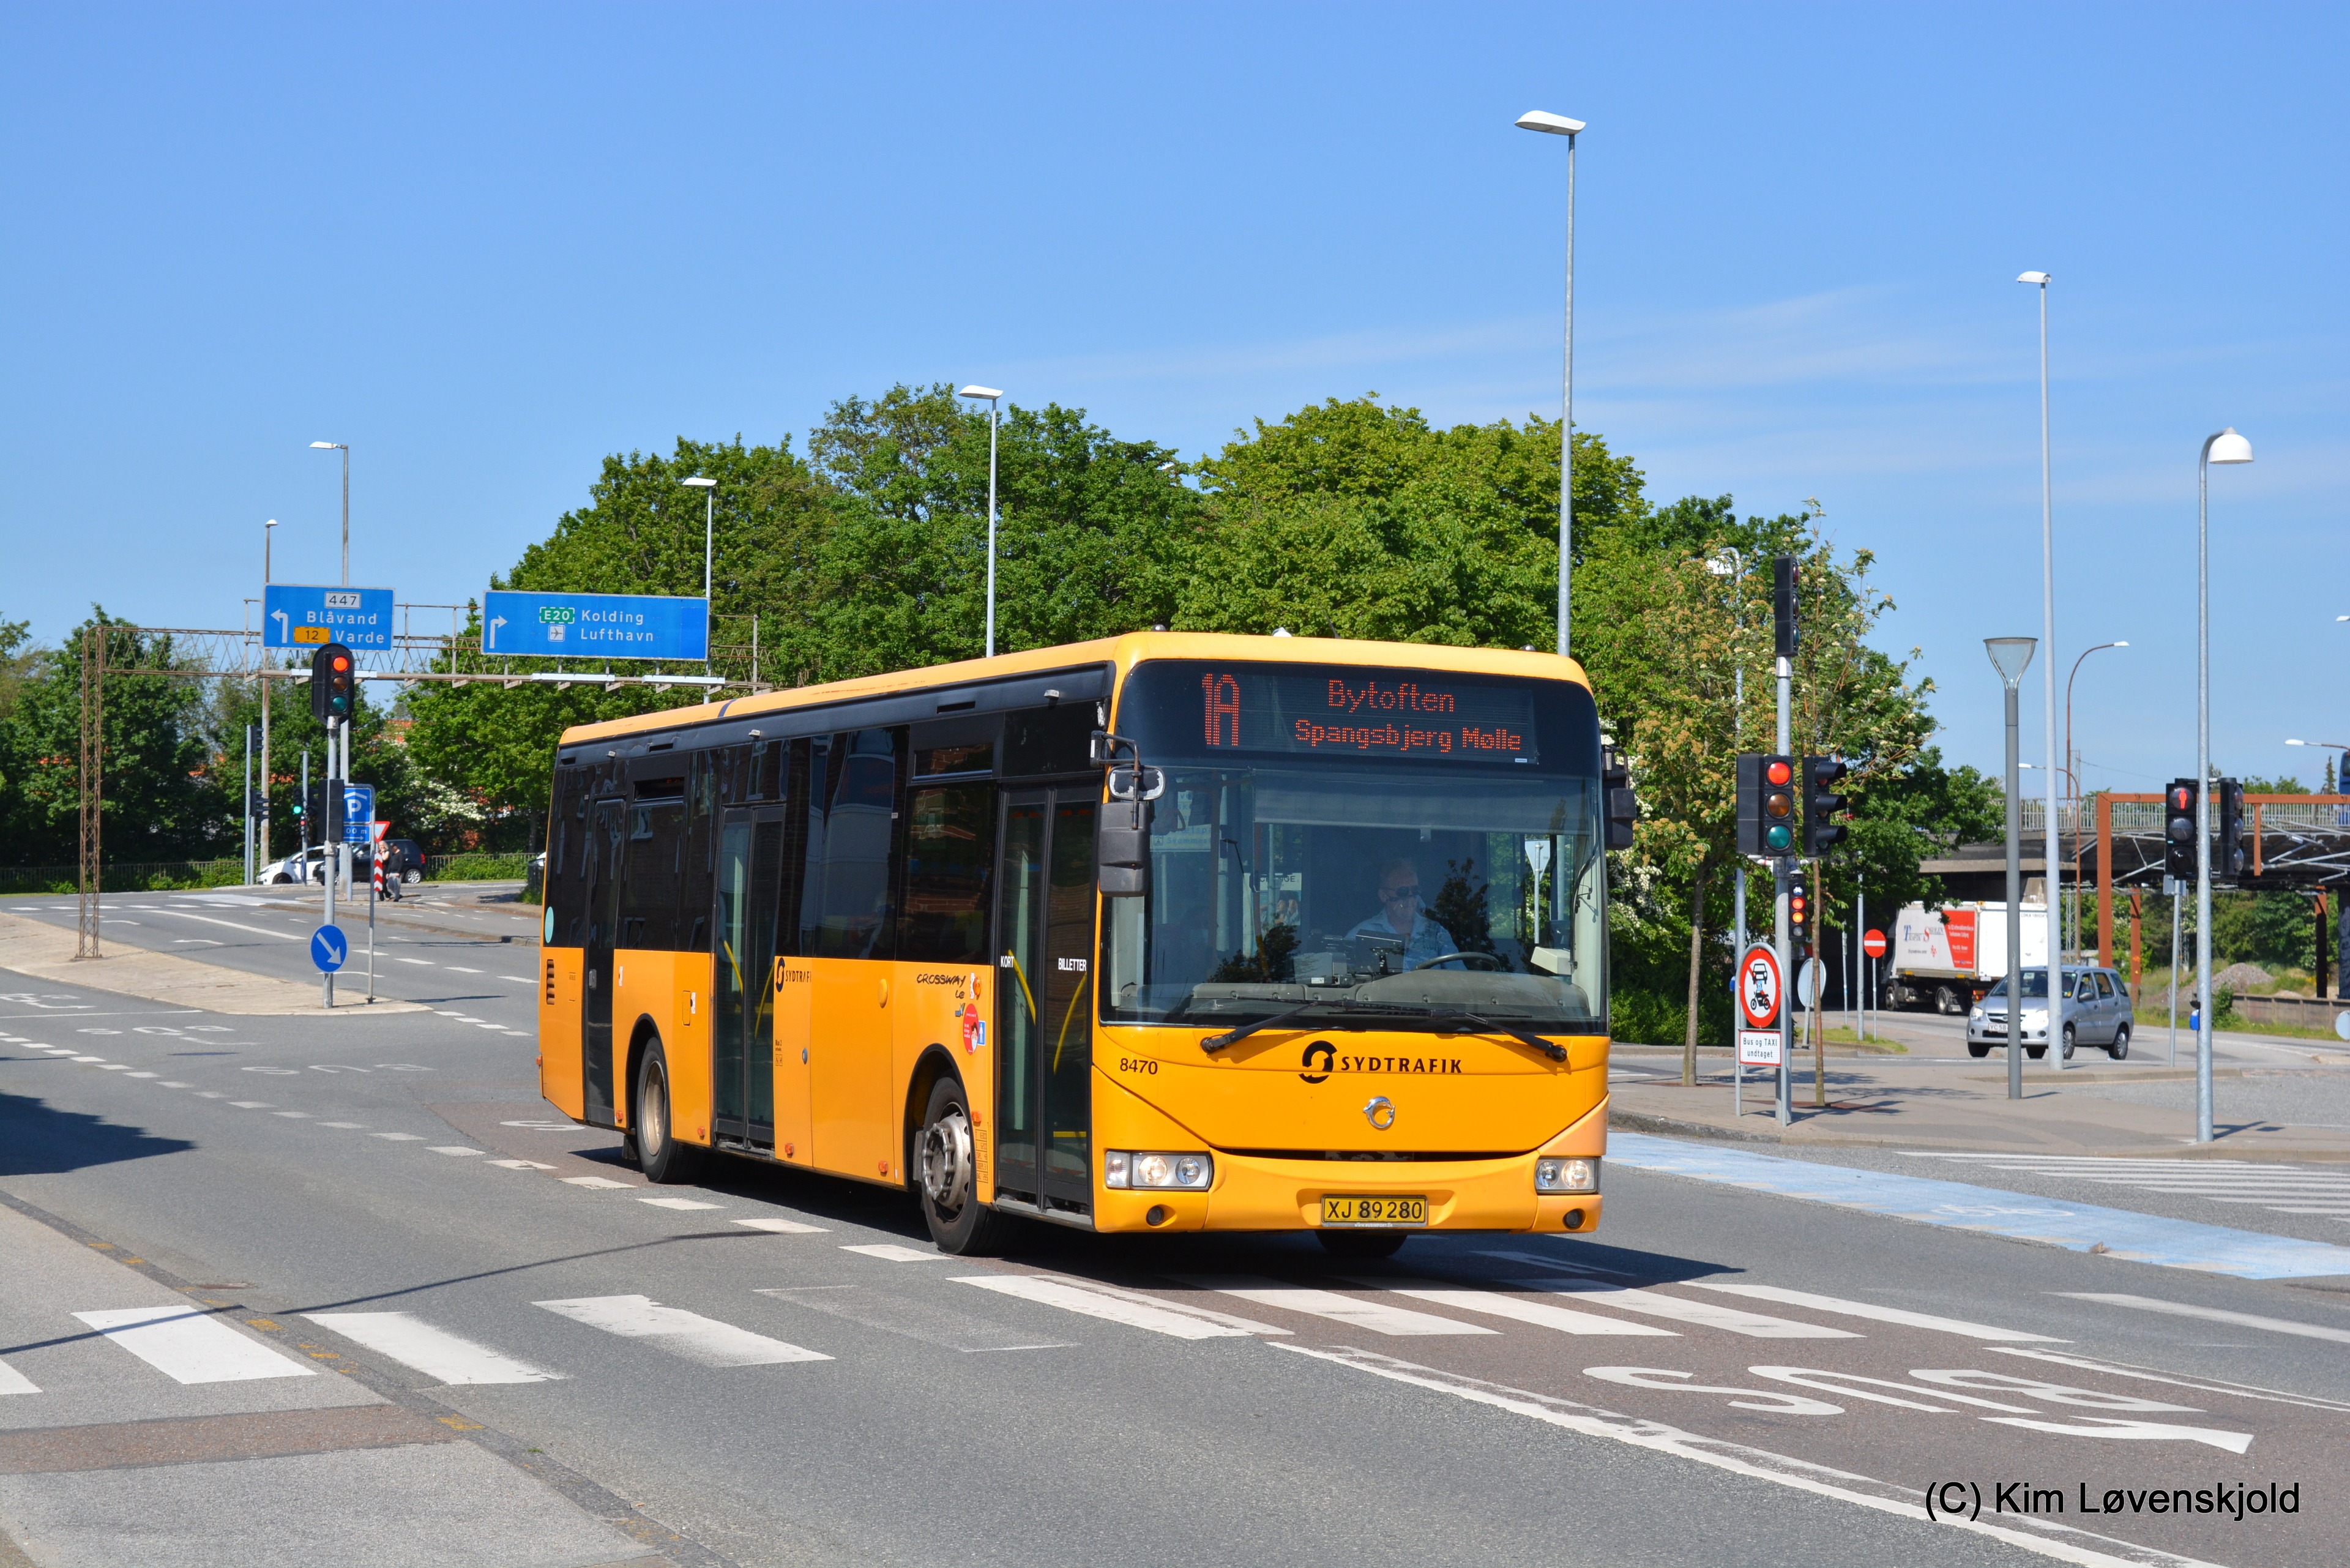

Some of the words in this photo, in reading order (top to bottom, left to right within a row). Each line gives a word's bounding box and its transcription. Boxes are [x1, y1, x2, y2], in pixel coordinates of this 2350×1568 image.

[329, 595, 357, 605] 447
[307, 611, 376, 624] Blåvand
[544, 610, 570, 621] E20
[581, 610, 643, 625] Kolding
[305, 630, 318, 640] 12
[335, 630, 384, 643] Varde
[581, 628, 653, 641] Lufthavn
[1328, 680, 1455, 712] Bytoften
[1202, 673, 1239, 745] 1A
[1295, 719, 1452, 752] Spangsbjerg
[1461, 727, 1521, 750] Mølle
[346, 799, 362, 819] P
[1001, 956, 1014, 968] KORT
[1058, 958, 1087, 971] BILLETTER
[917, 974, 966, 987] CROSSWAY
[1747, 1049, 1773, 1059] undtaget
[1119, 1058, 1158, 1075] 8470
[1340, 1056, 1463, 1074] SYDTRAFIK
[1327, 1201, 1351, 1219] XJ
